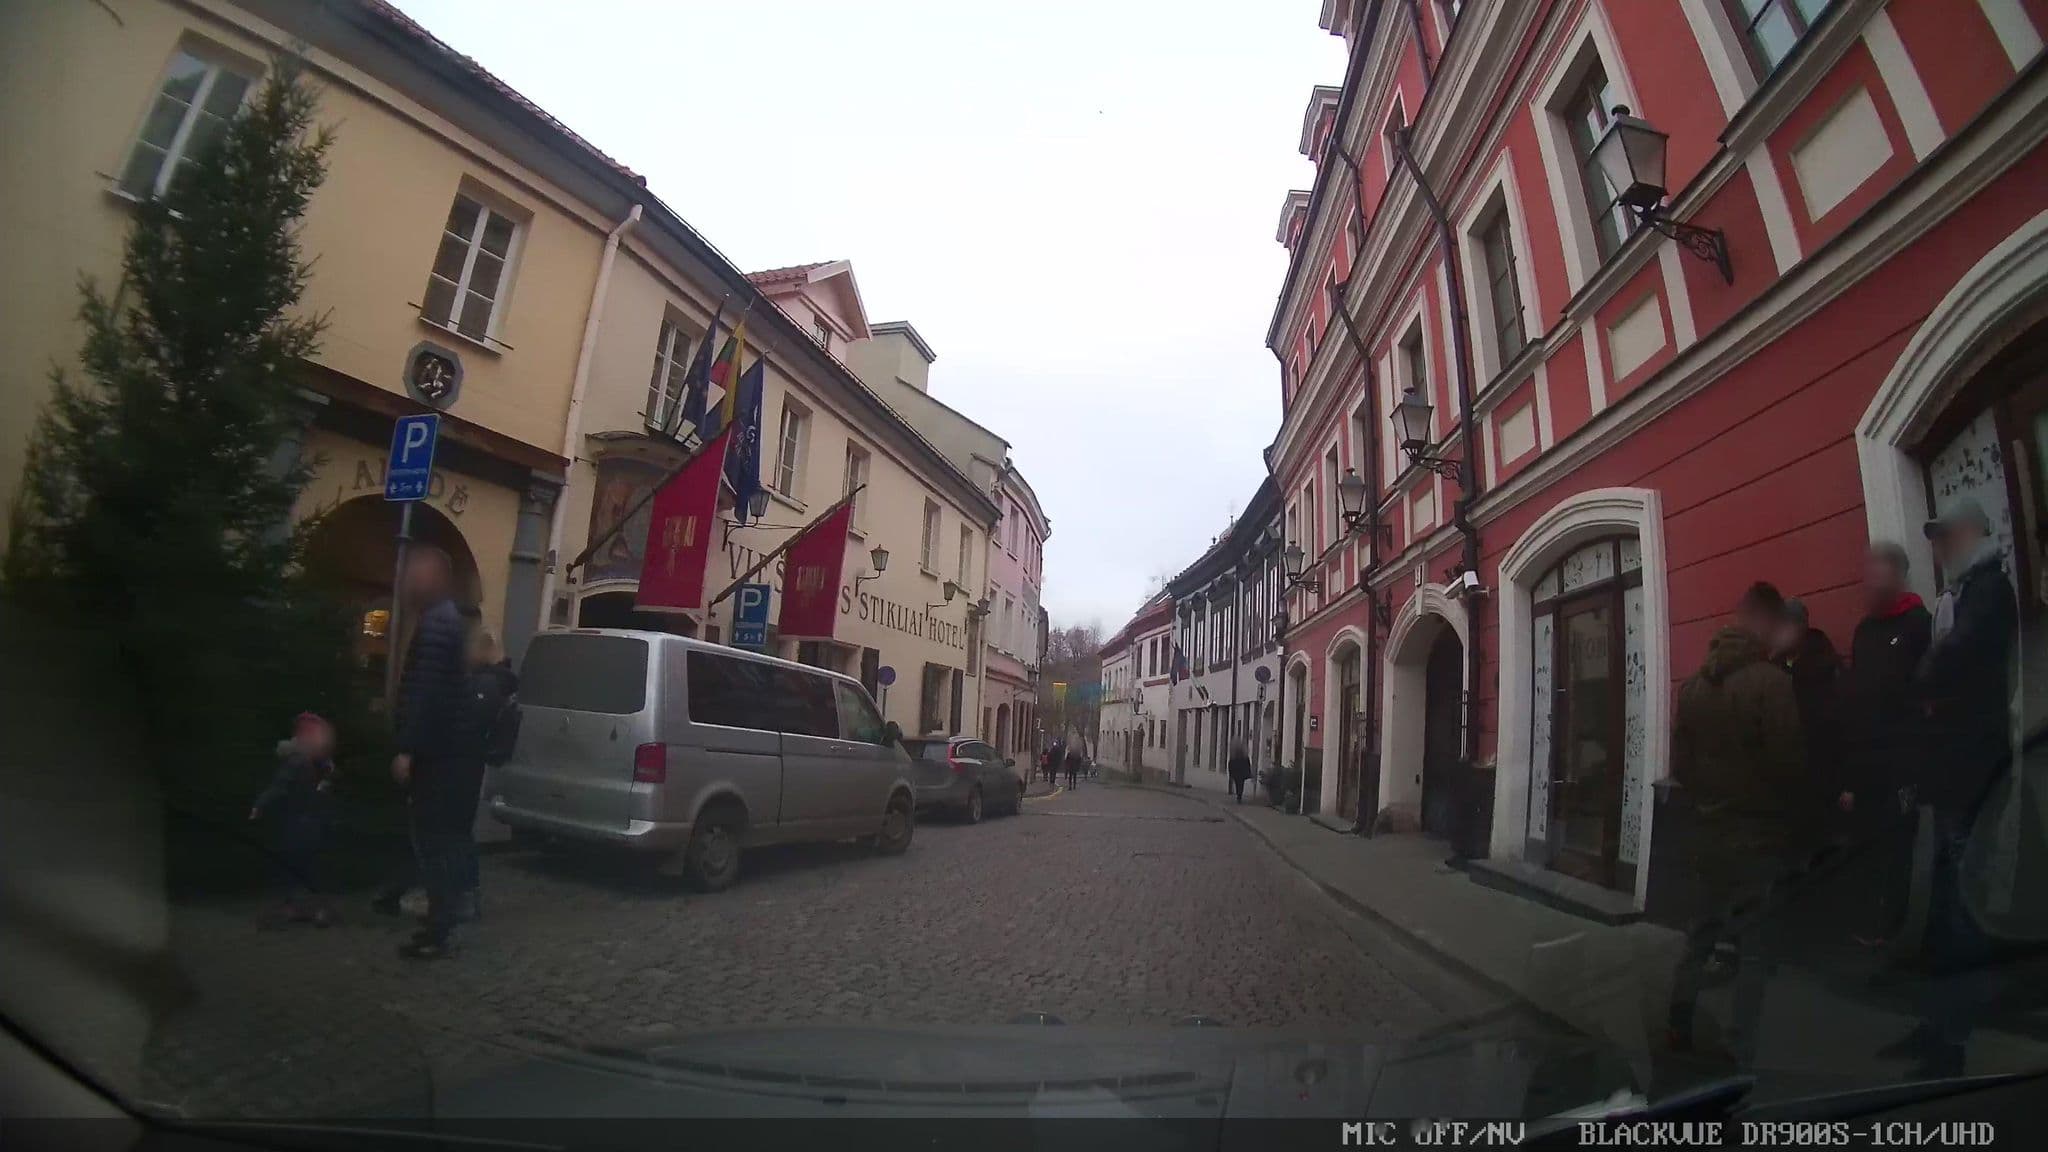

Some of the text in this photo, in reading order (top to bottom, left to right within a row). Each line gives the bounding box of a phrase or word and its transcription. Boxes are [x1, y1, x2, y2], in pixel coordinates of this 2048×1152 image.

[401, 422, 428, 464] P
[740, 587, 762, 619] P
[858, 591, 924, 637] STIKLIAI
[928, 616, 965, 650] HOTEL
